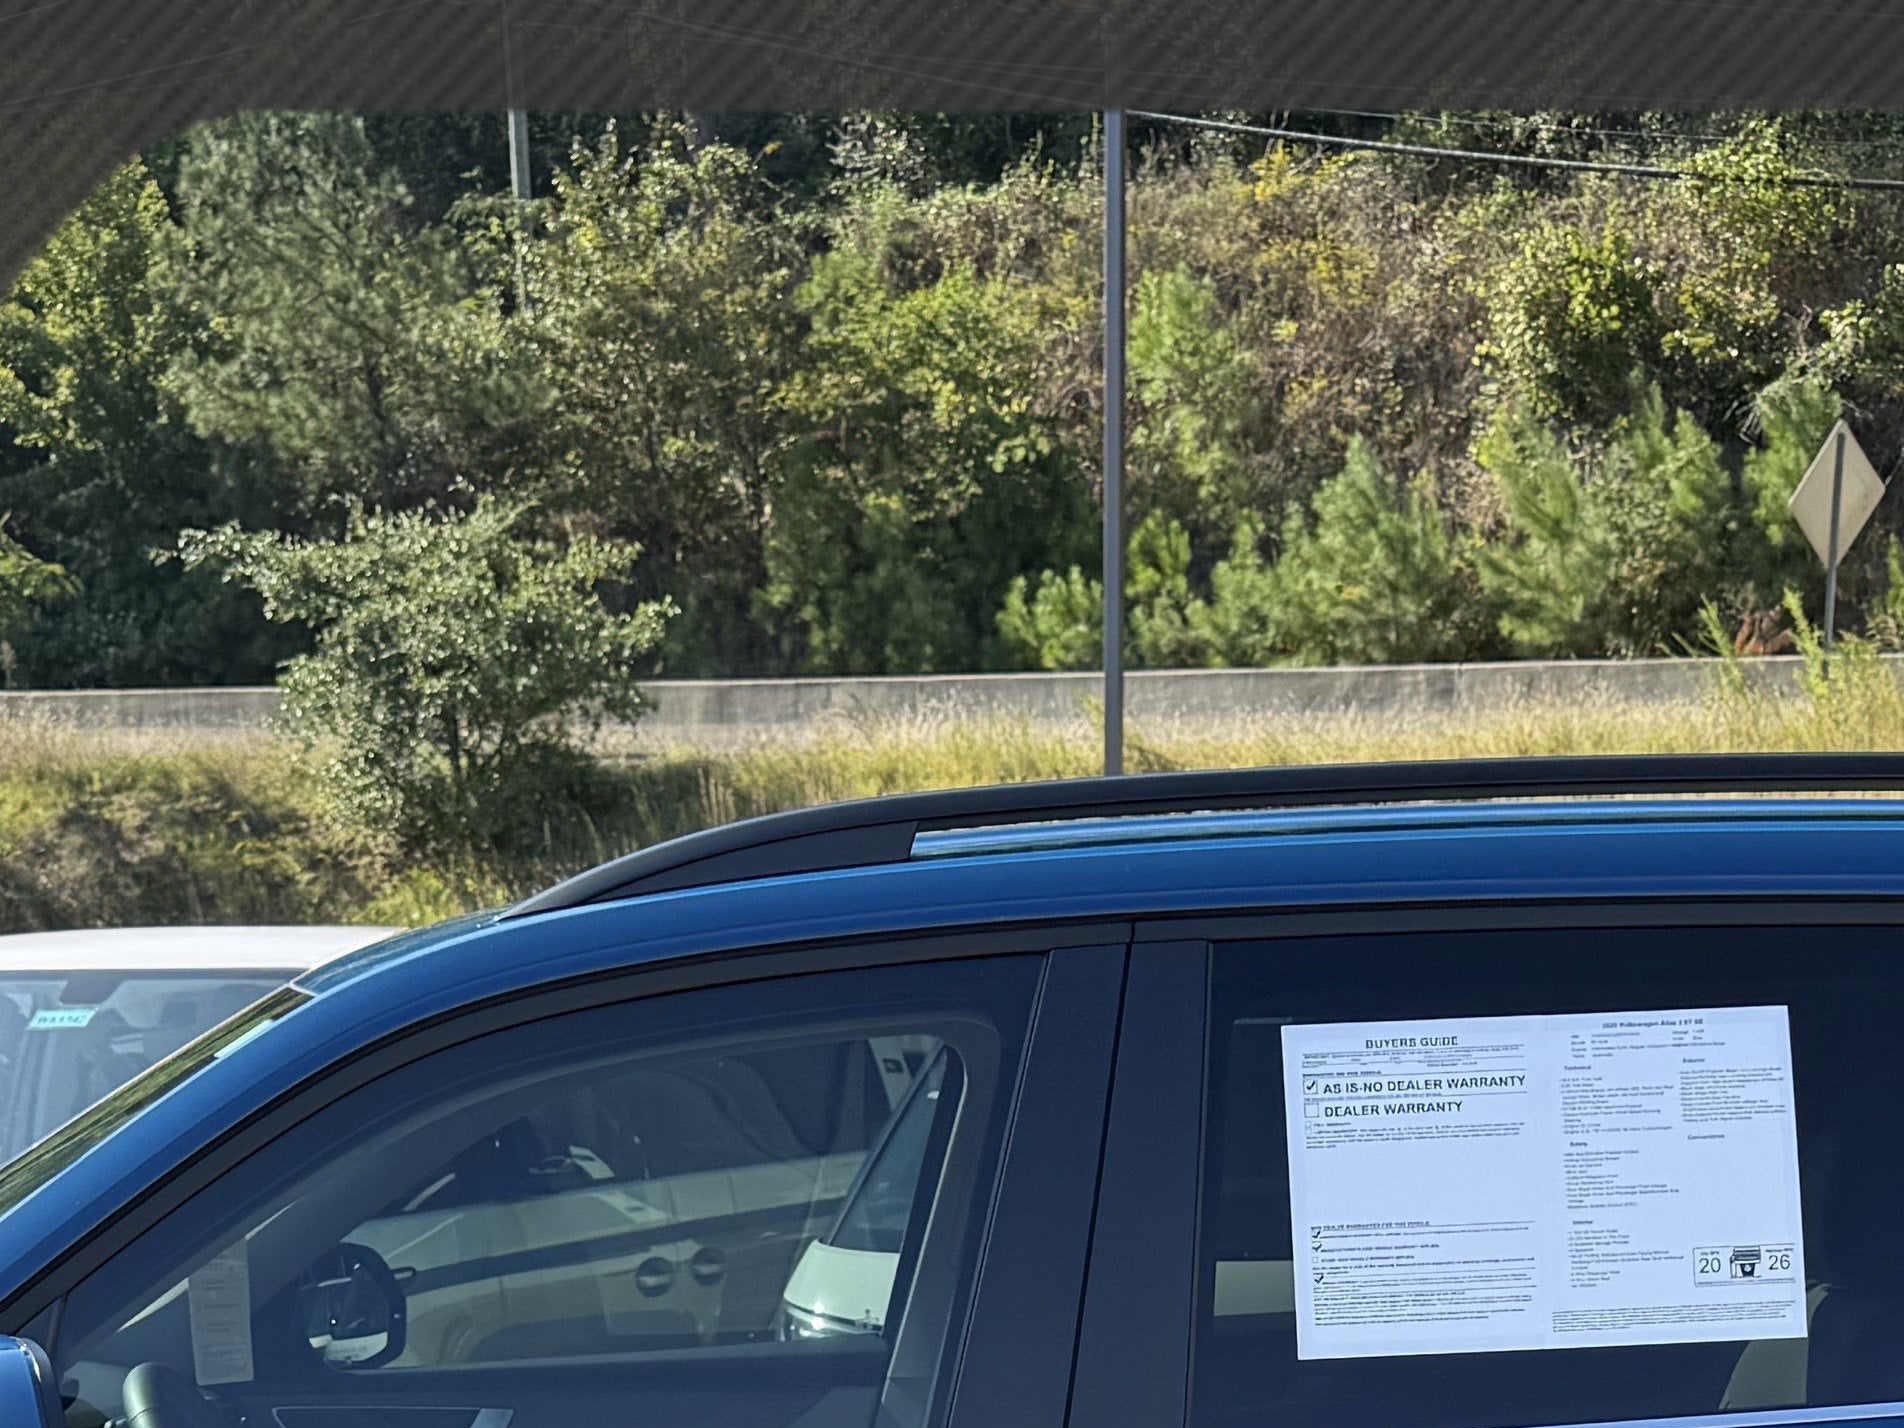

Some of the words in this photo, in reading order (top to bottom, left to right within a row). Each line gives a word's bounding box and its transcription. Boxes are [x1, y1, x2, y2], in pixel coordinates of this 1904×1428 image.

[1421, 1036, 1459, 1047] GUIDE
[1323, 1083, 1342, 1094] AS
[1387, 1078, 1442, 1091] DEALER
[1446, 1075, 1526, 1089] WARRANTY
[1324, 1104, 1380, 1117] DEALER
[1383, 1101, 1463, 1115] WARRANTY
[1699, 1257, 1722, 1274] 20
[1768, 1253, 1791, 1270] 26
